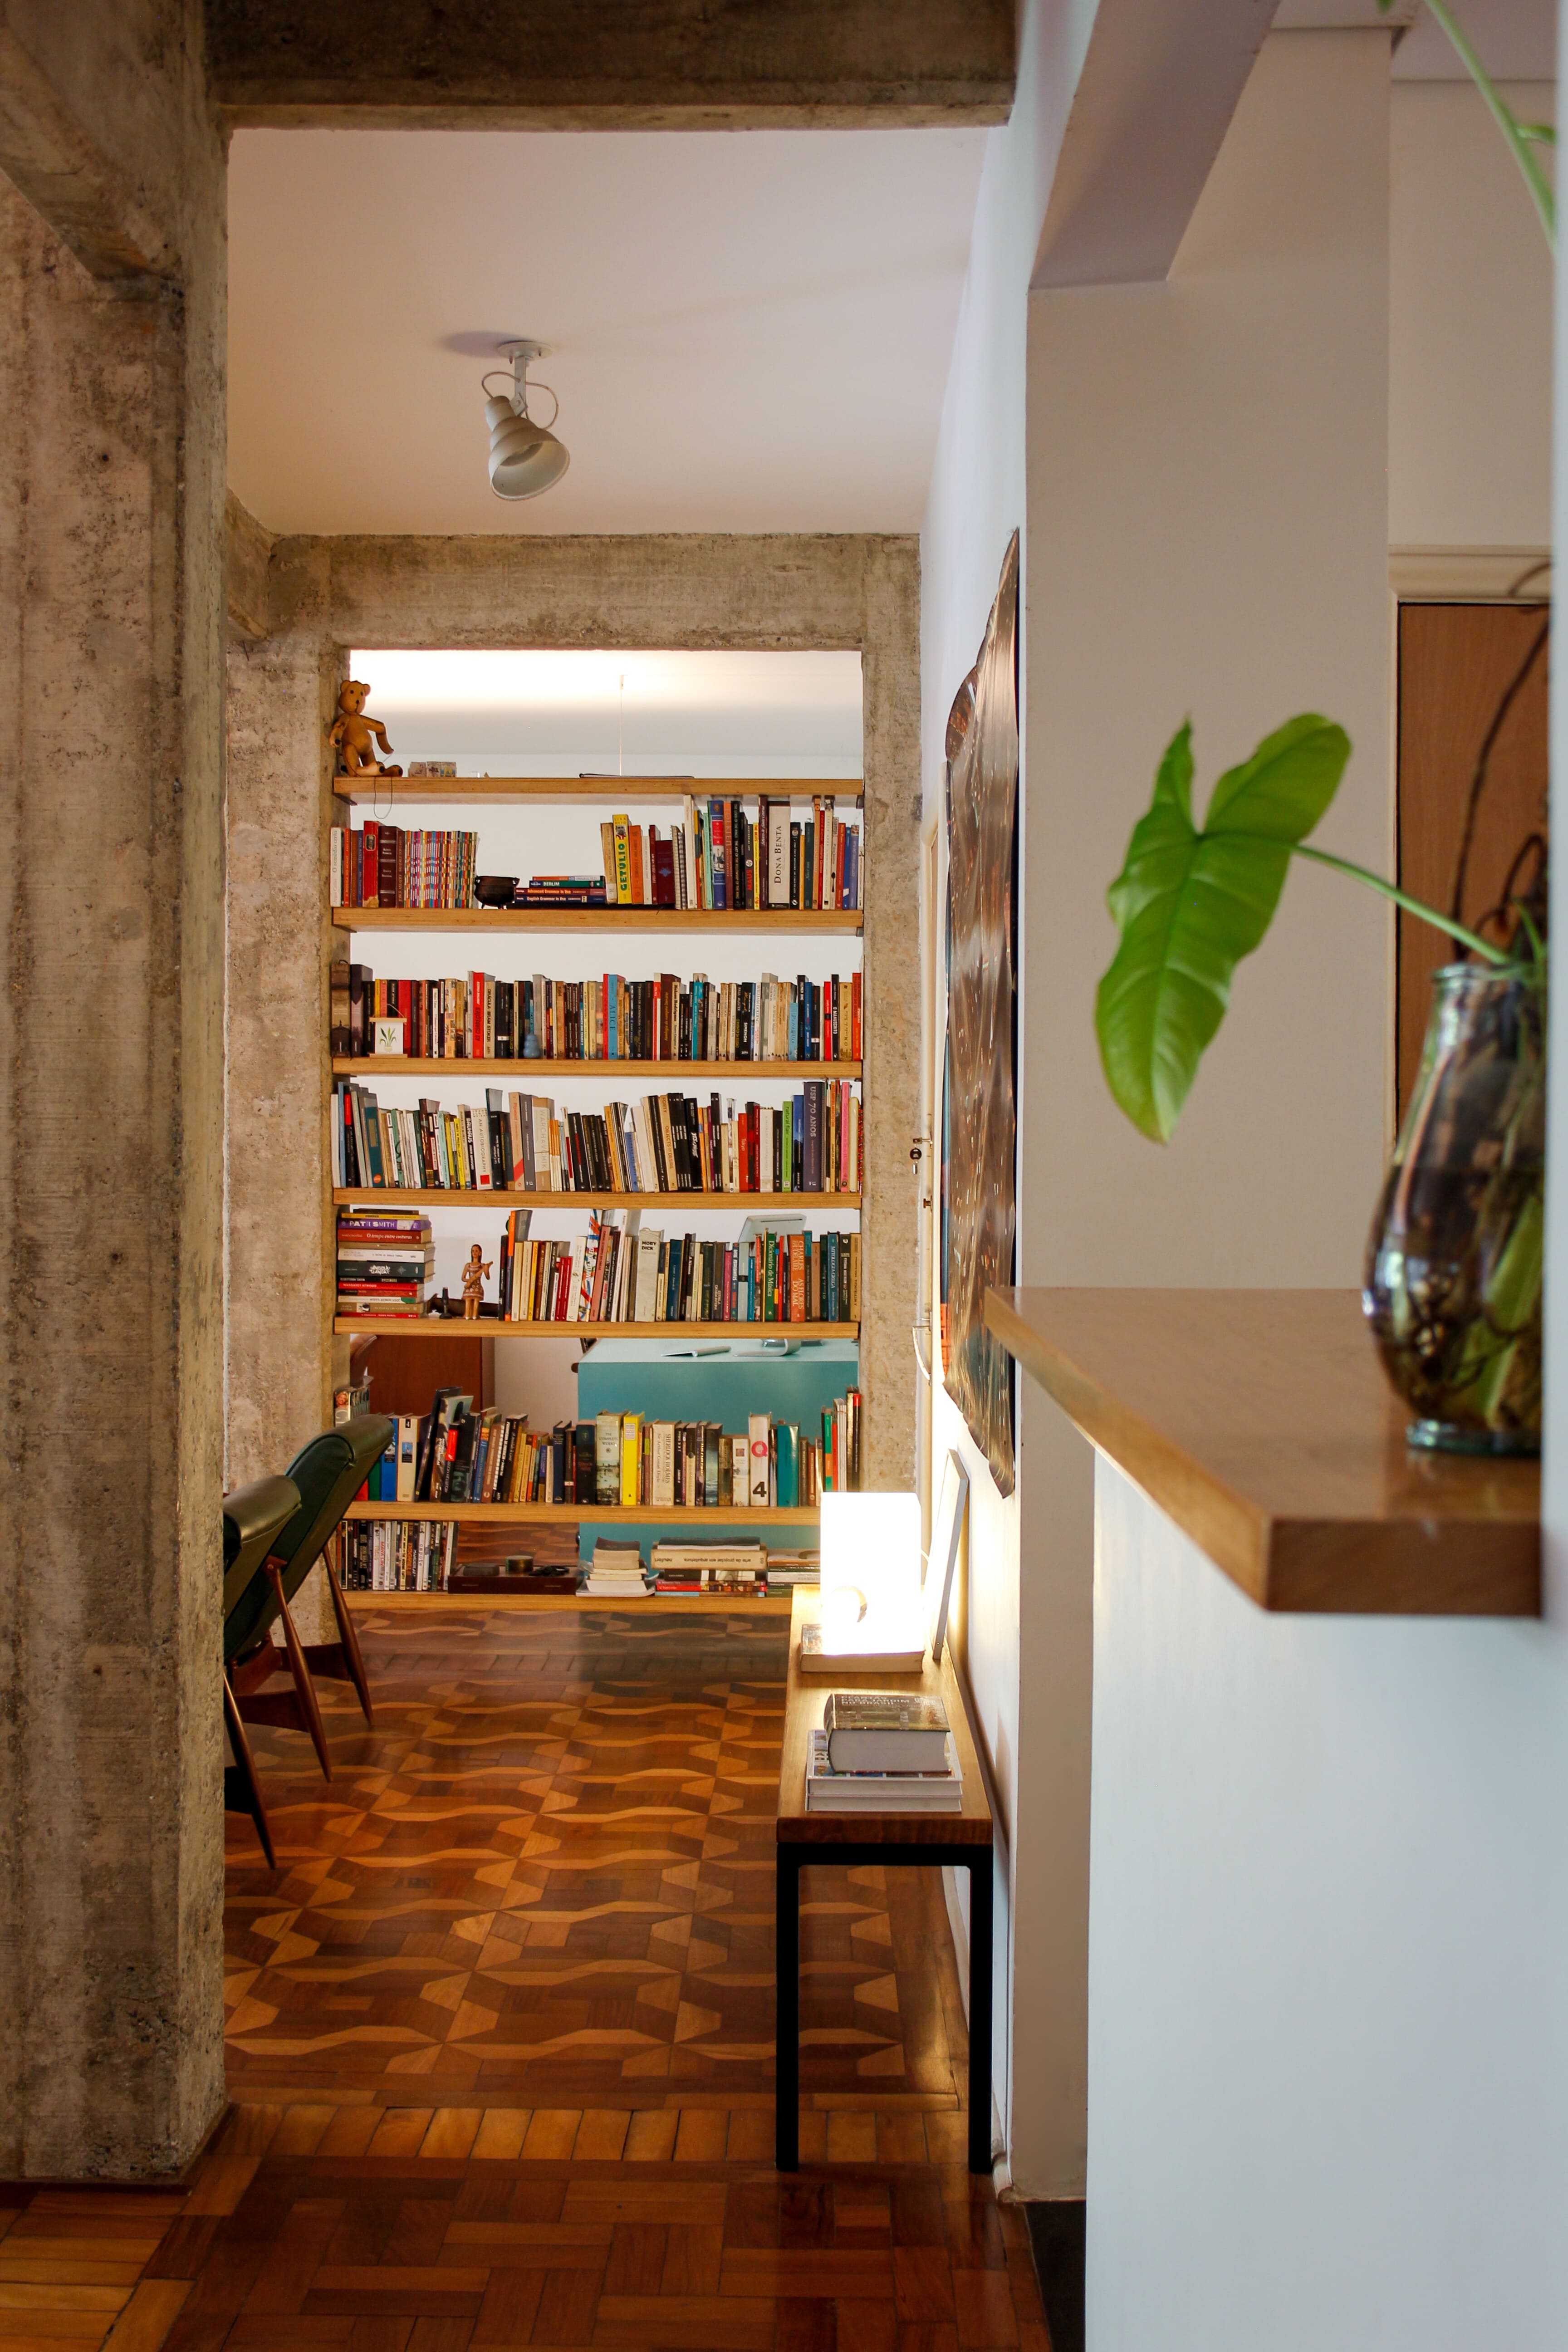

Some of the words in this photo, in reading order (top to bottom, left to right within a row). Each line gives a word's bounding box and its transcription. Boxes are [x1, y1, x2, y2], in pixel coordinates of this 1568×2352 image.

[617, 843, 627, 891] GETÚLIO
[808, 1103, 816, 1114] 70
[539, 1109, 548, 1169] WARCHAVCHIK
[793, 1281, 798, 1291] DO
[799, 1278, 804, 1286] AS
[751, 1441, 768, 1458] Q
[753, 1481, 767, 1497] 4
